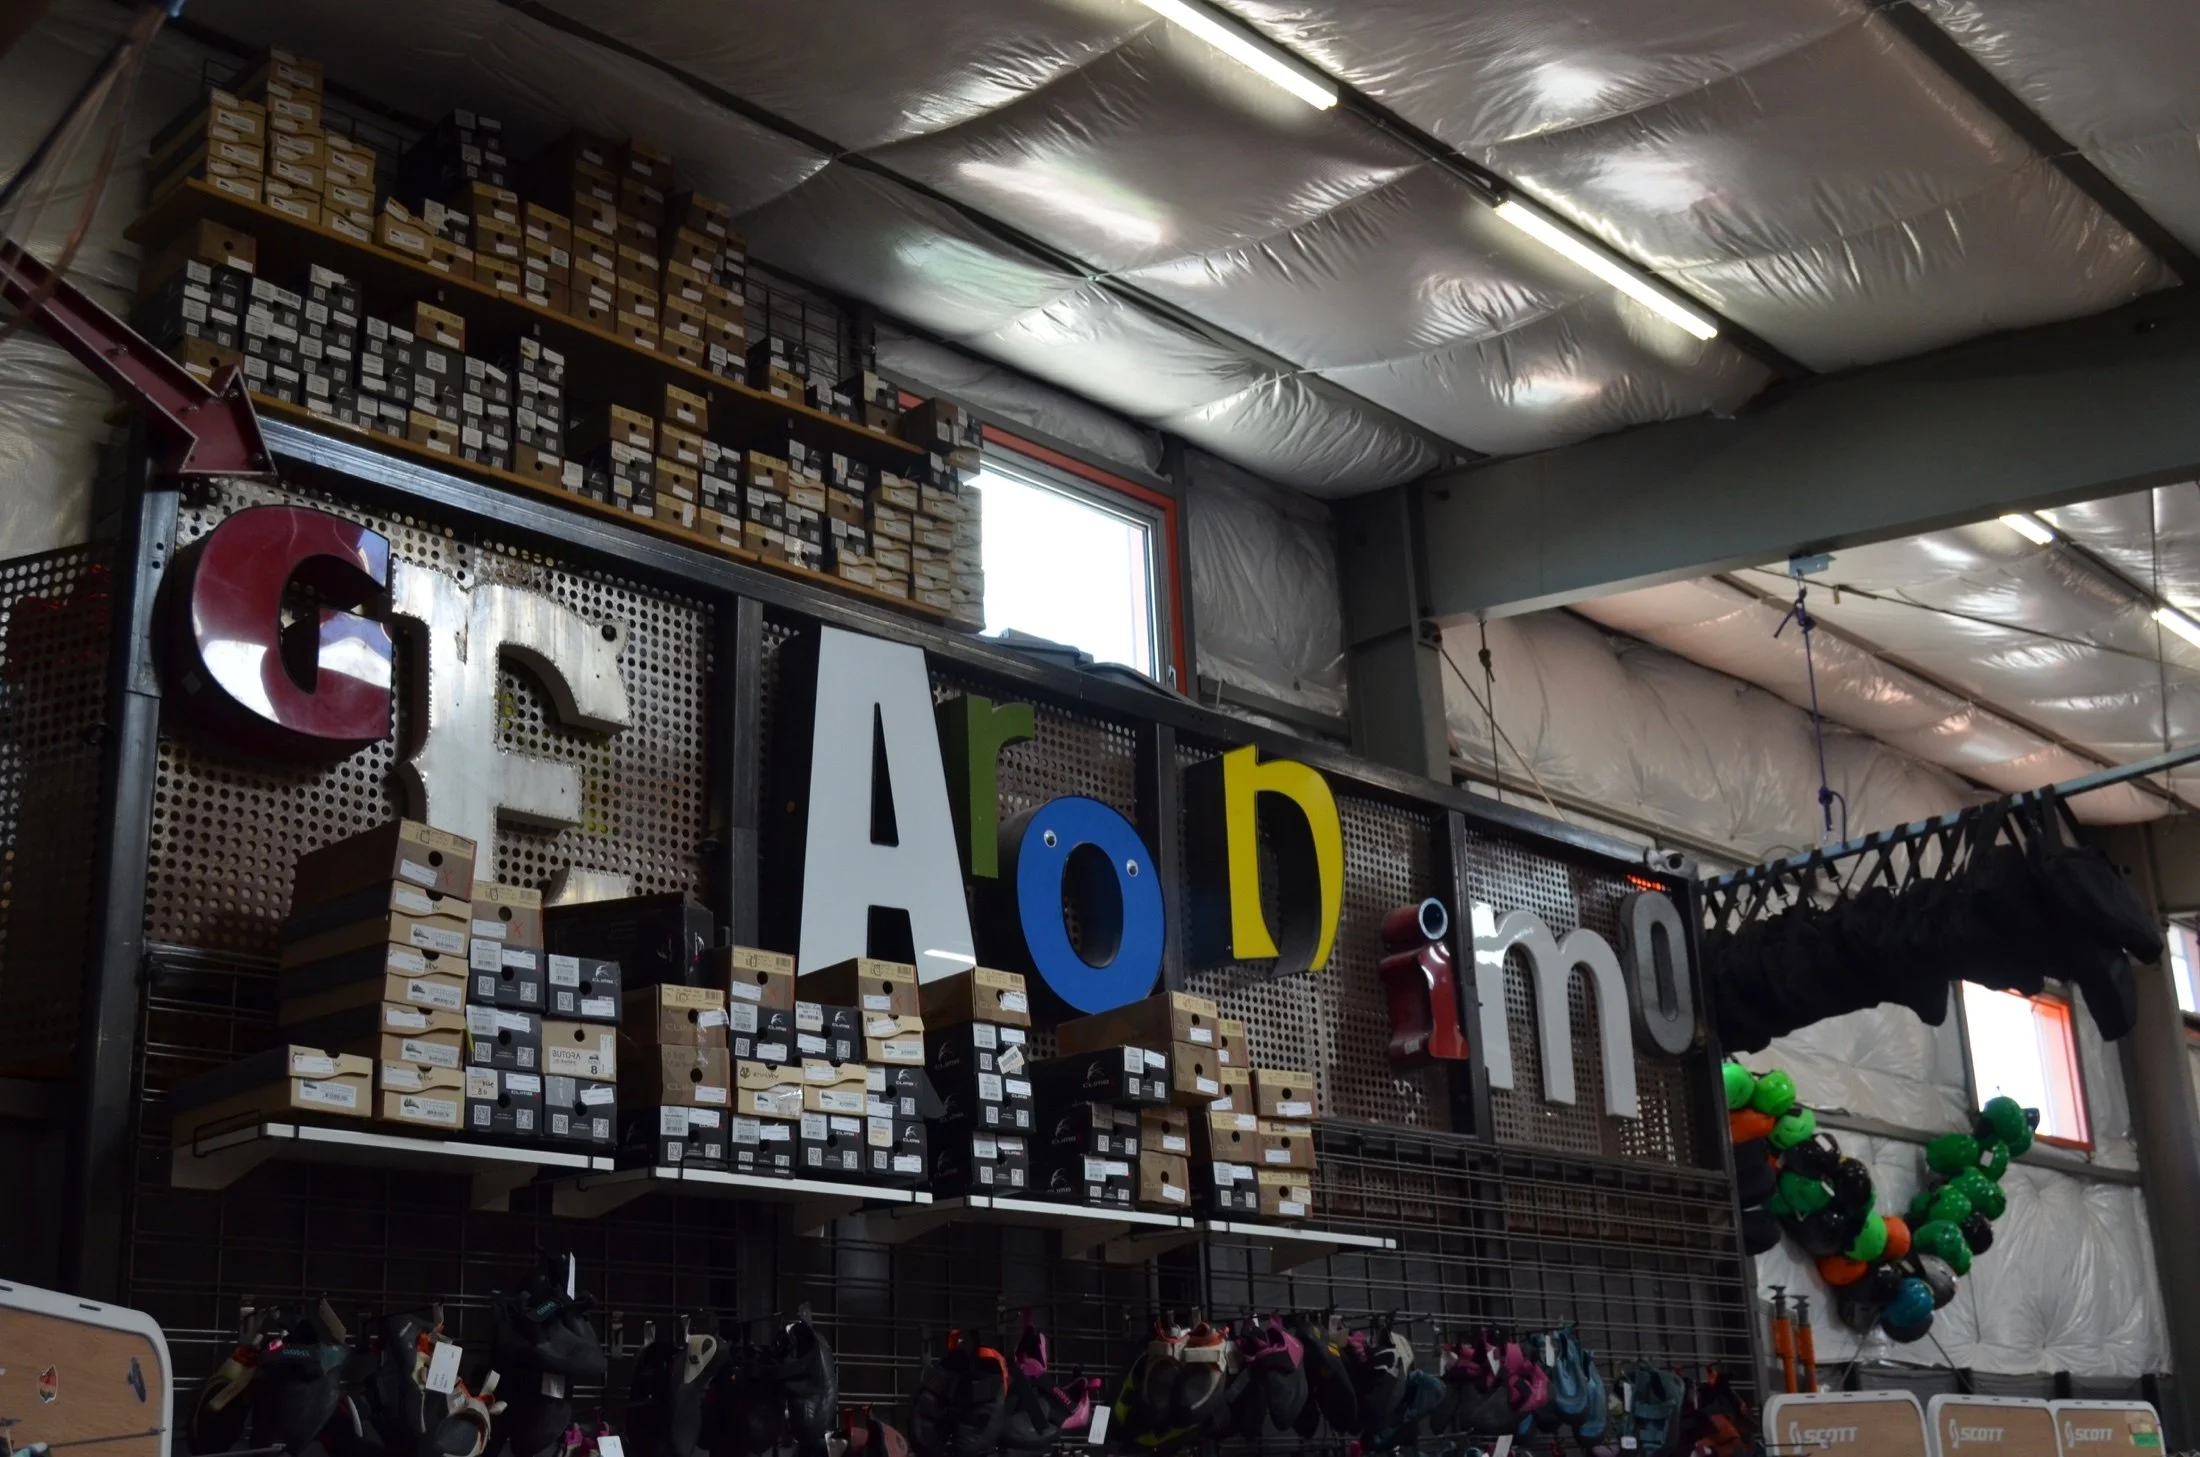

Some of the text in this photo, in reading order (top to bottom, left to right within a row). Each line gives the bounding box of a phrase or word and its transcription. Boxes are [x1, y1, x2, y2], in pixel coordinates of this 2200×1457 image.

[590, 1065, 598, 1075] 8
[1804, 1426, 1858, 1443] SCOTT
[1960, 1427, 2004, 1442] SCOTT
[2075, 1428, 2113, 1442] SCOTT
